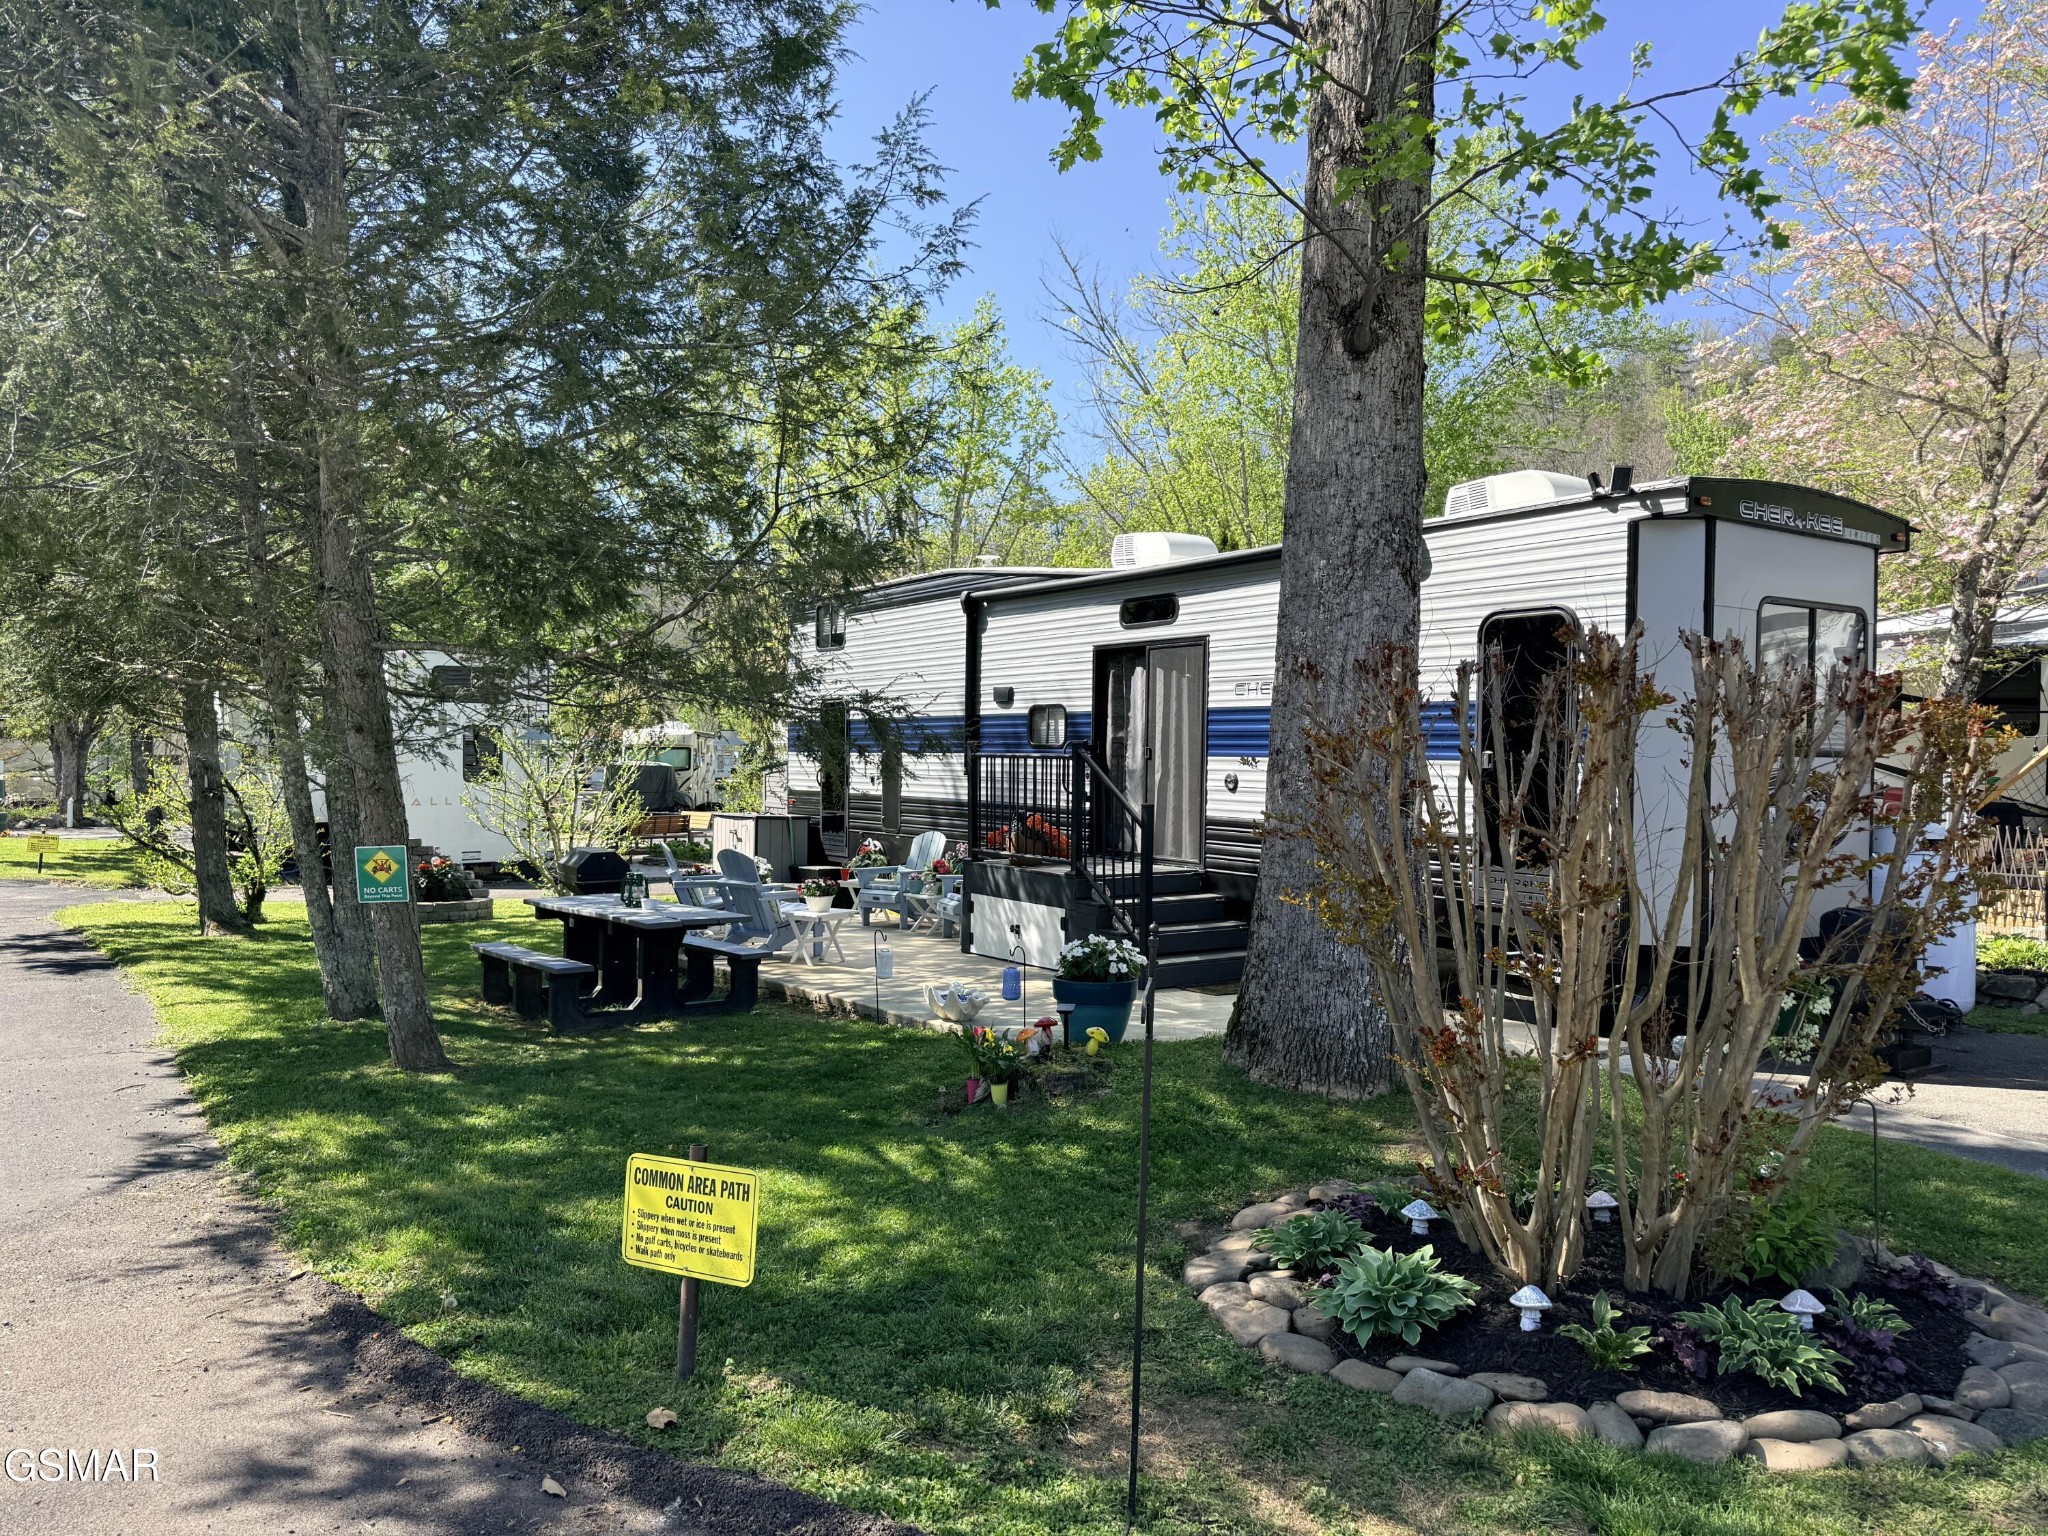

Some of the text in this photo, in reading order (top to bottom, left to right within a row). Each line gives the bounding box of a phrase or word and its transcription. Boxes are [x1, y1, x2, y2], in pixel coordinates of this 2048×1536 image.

[377, 886, 403, 894] CARTS
[633, 1166, 750, 1202] COMMON AREA PATH
[665, 1195, 714, 1215] CAUTION
[636, 1220, 722, 1245] Slippery when moss is present
[637, 1208, 736, 1235] Slippery when wet or ice is present
[635, 1232, 743, 1262] No golf carts, bicycles or skateboards
[635, 1244, 676, 1263] Walk path only
